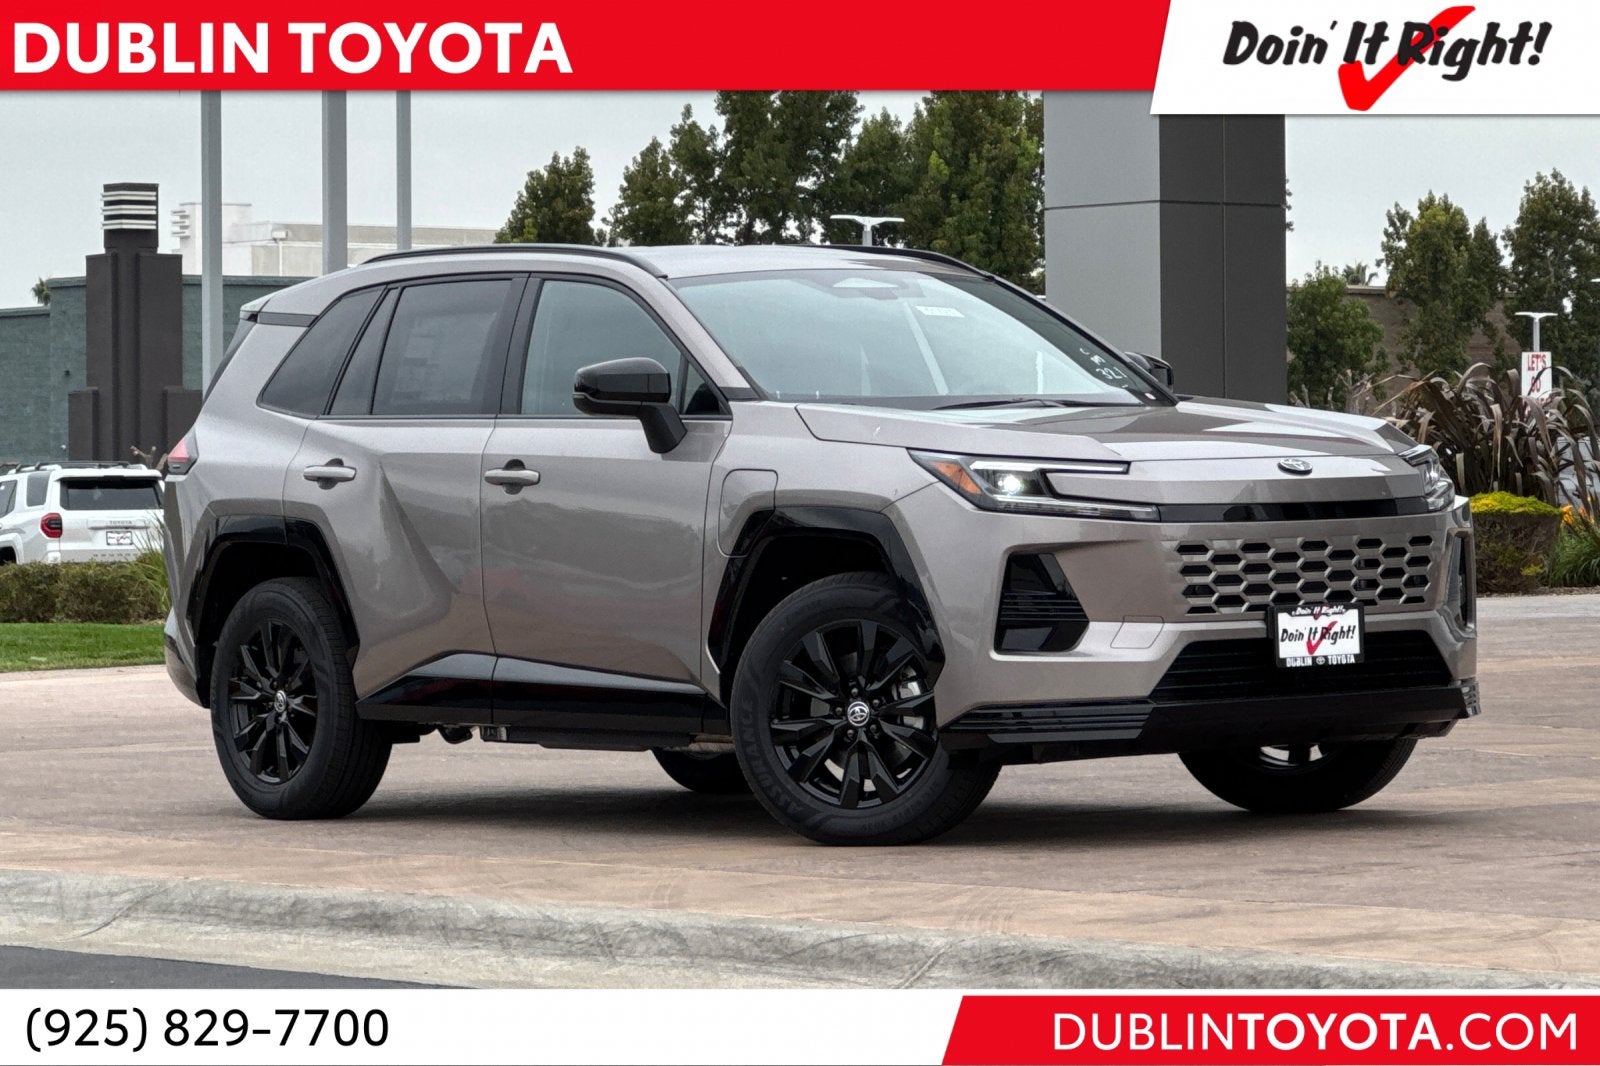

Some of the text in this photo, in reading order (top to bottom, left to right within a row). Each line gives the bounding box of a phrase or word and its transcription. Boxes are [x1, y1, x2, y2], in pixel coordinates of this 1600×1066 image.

[1280, 625, 1356, 645] Doin' It Right!
[1286, 654, 1355, 668] DUBLIN TOYOTA
